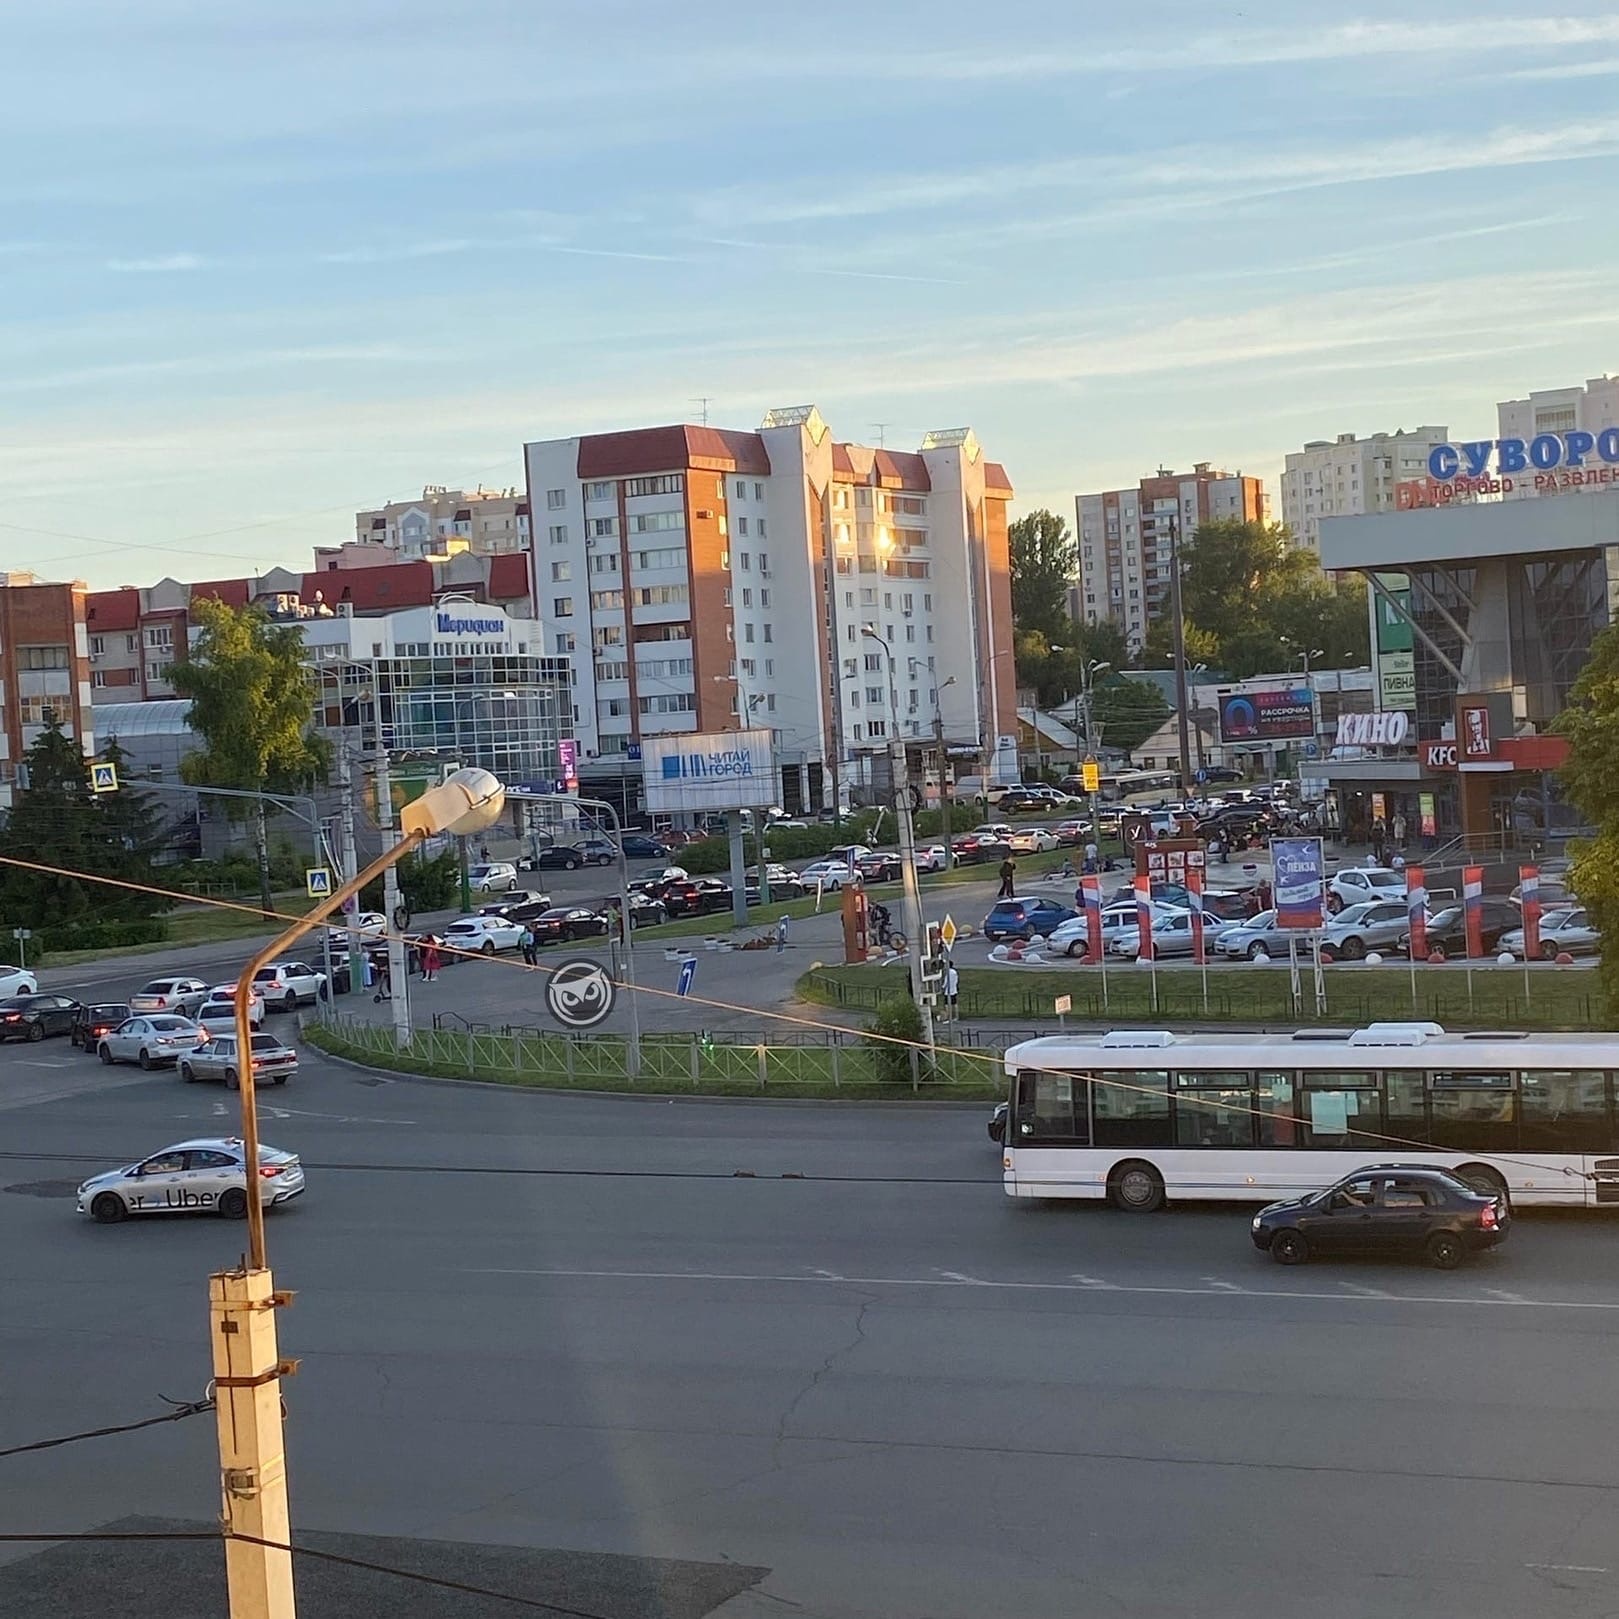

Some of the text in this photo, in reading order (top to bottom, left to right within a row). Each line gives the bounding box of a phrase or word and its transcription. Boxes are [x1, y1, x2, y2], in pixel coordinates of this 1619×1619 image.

[1428, 428, 1619, 480] СУВОРО
[1433, 478, 1513, 498] ТОРГОВО
[1335, 711, 1409, 745] КИНО
[708, 748, 750, 763] ЧИТАЙ
[1427, 746, 1457, 765] KFC
[709, 762, 752, 776] ГОРОД
[1287, 862, 1316, 873] ПЕНЗА
[166, 1187, 219, 1207] Uber
